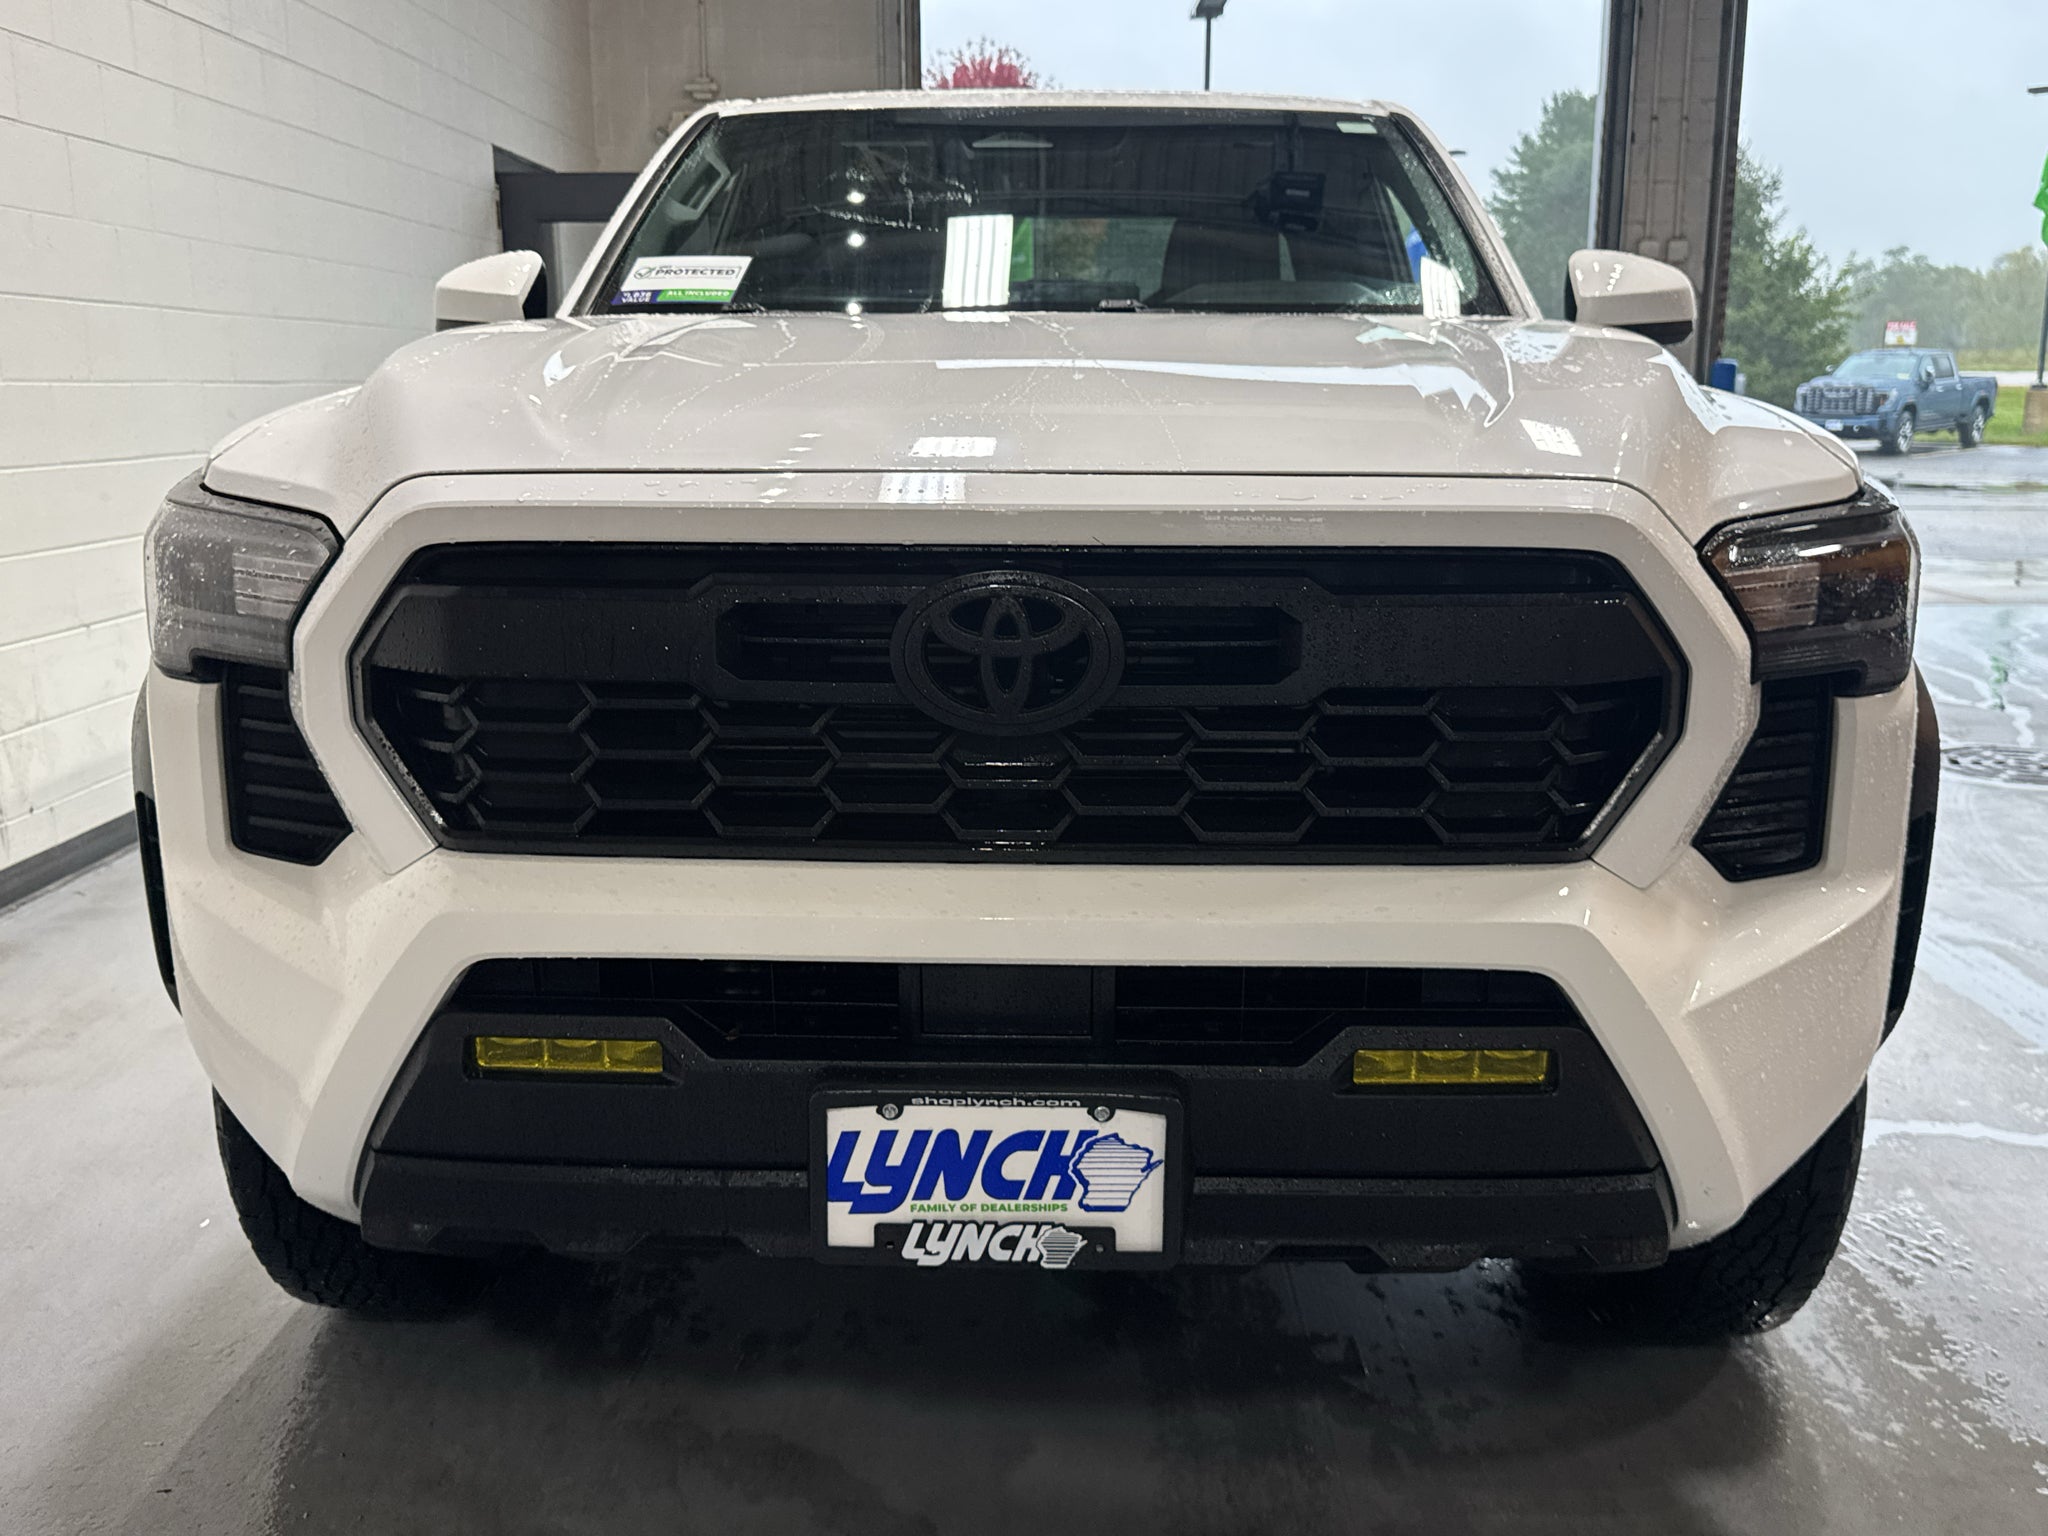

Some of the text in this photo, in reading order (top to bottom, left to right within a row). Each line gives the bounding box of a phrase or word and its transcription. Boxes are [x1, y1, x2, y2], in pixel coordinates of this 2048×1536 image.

[655, 268, 735, 276] PROTECTED
[911, 1096, 1081, 1107] shoplynch.com
[827, 1129, 1099, 1214] LYNCH
[910, 1203, 1068, 1212] FAMILY OF DEALERSHIPS
[901, 1222, 1052, 1266] LYNCH
